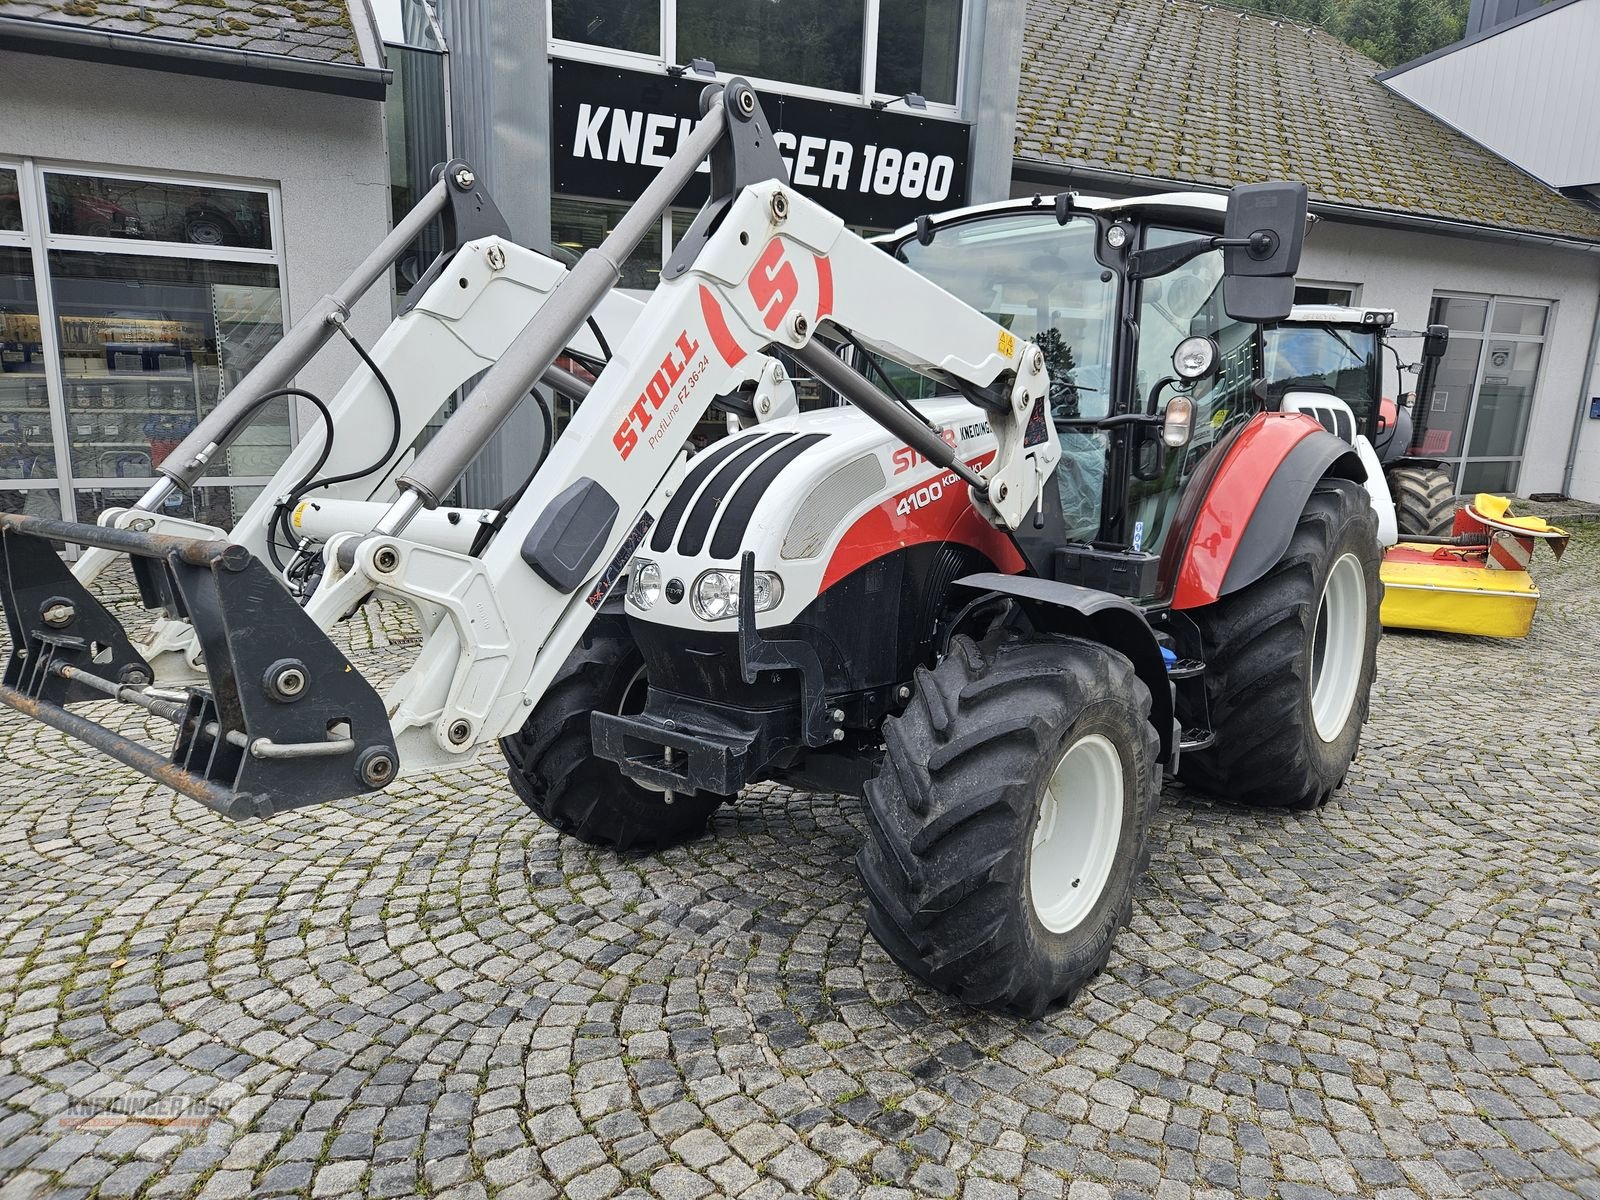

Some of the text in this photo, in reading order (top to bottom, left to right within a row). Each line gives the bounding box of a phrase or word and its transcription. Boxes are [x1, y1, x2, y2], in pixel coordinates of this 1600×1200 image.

[573, 103, 954, 202] KNEIGER 1880
[748, 237, 799, 332] S
[612, 329, 700, 462] STOLL
[648, 355, 710, 450] ProfiLine FZ 36-24
[960, 421, 993, 441] KNEIDING
[892, 428, 958, 476] STR
[896, 462, 982, 516] 4100 KOKT
